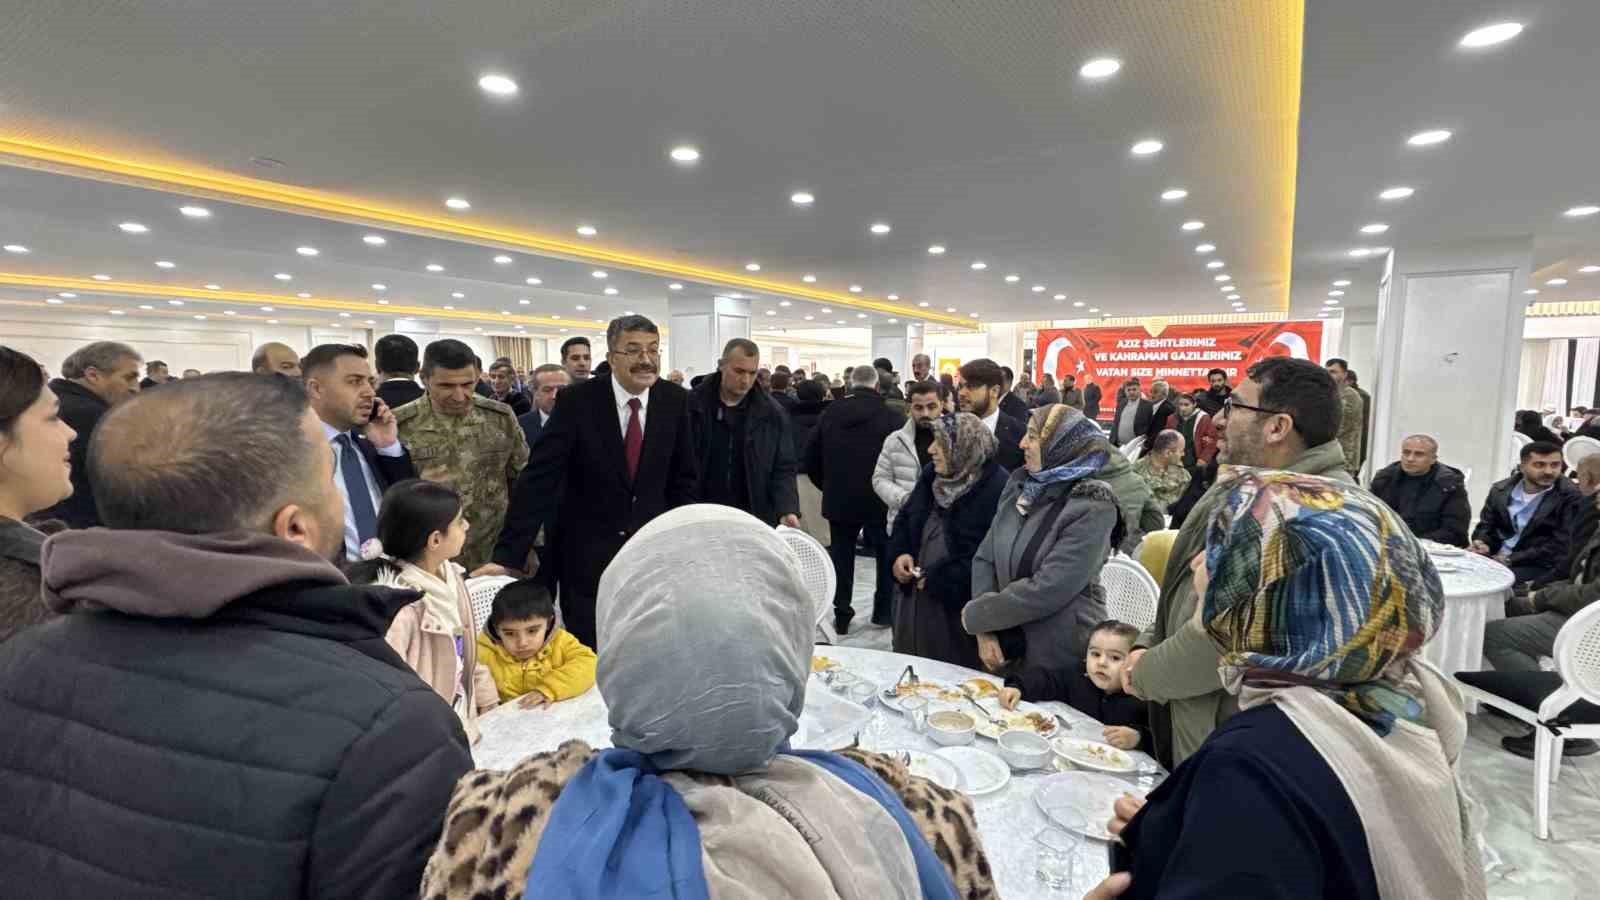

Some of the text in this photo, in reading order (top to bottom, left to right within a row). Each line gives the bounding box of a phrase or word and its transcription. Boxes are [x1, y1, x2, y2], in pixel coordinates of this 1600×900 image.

[1094, 352, 1107, 361] VE
[1110, 351, 1168, 361] KAHRAMAN
[1096, 368, 1128, 377] VATAN
